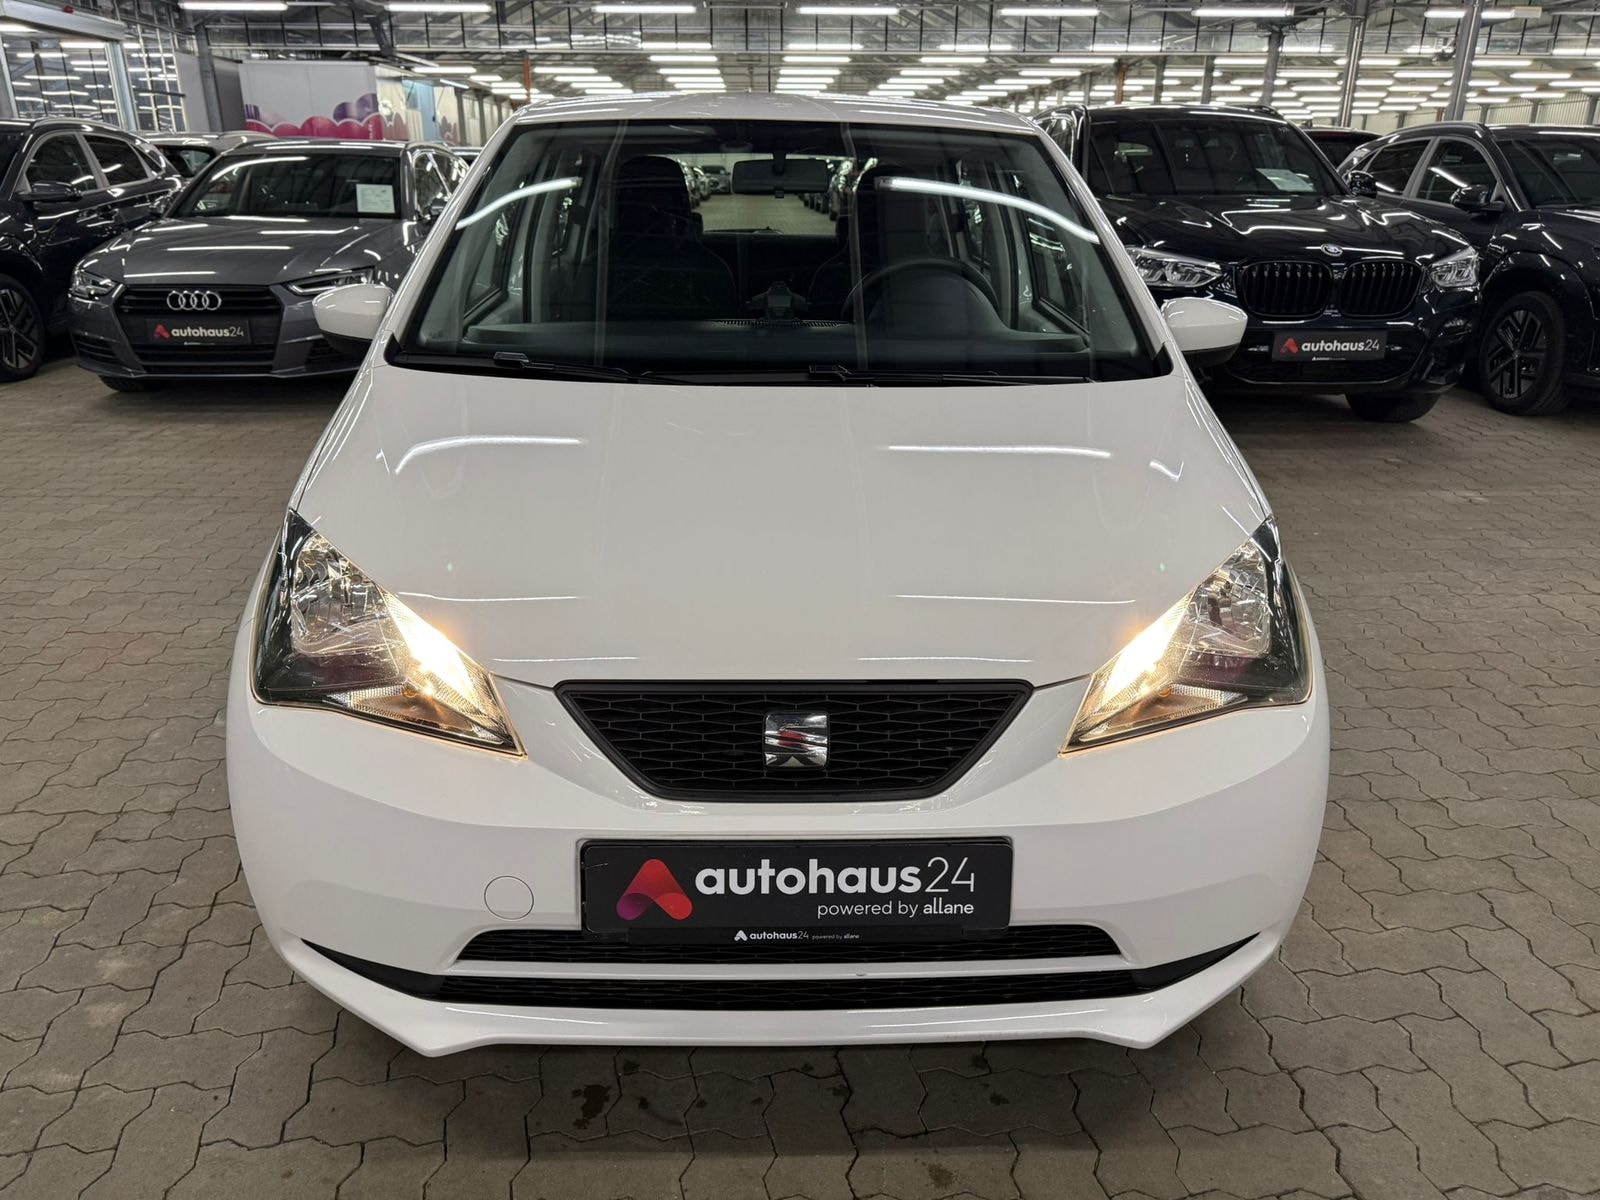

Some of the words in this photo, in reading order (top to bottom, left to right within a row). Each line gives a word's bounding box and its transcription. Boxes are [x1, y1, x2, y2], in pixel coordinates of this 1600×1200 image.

[171, 326, 244, 337] autohaus24
[1301, 339, 1379, 352] autohaus24
[695, 856, 975, 895] autohaus24
[818, 900, 893, 919] powered
[897, 900, 919, 919] by
[923, 897, 975, 915] allane
[749, 930, 809, 940] autohaus24
